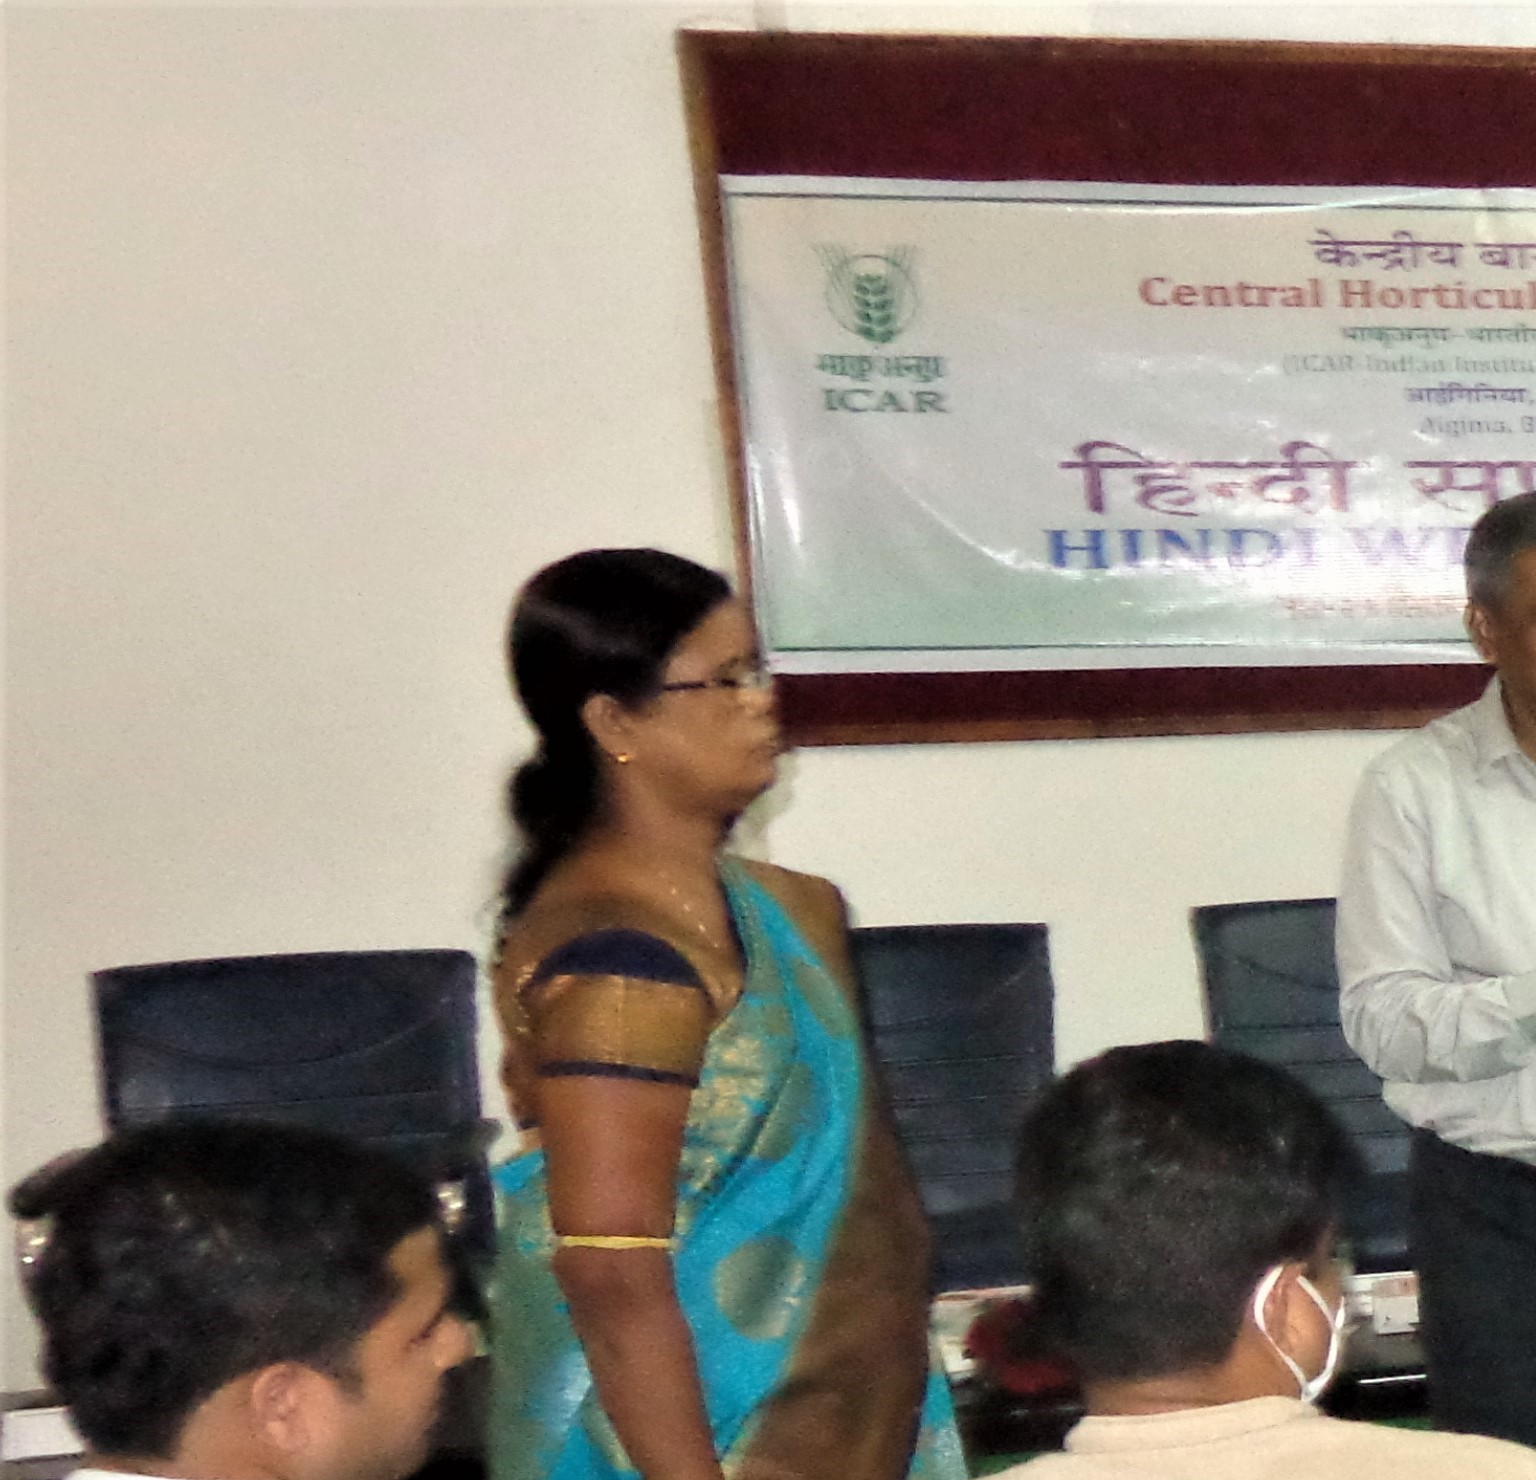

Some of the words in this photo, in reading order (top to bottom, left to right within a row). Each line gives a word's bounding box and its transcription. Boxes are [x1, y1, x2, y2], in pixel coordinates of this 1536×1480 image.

[1138, 277, 1324, 308] Central
[821, 387, 952, 414] ICAR
[1060, 441, 1366, 517] हिन्दी
[1044, 528, 1322, 570] HINDI
